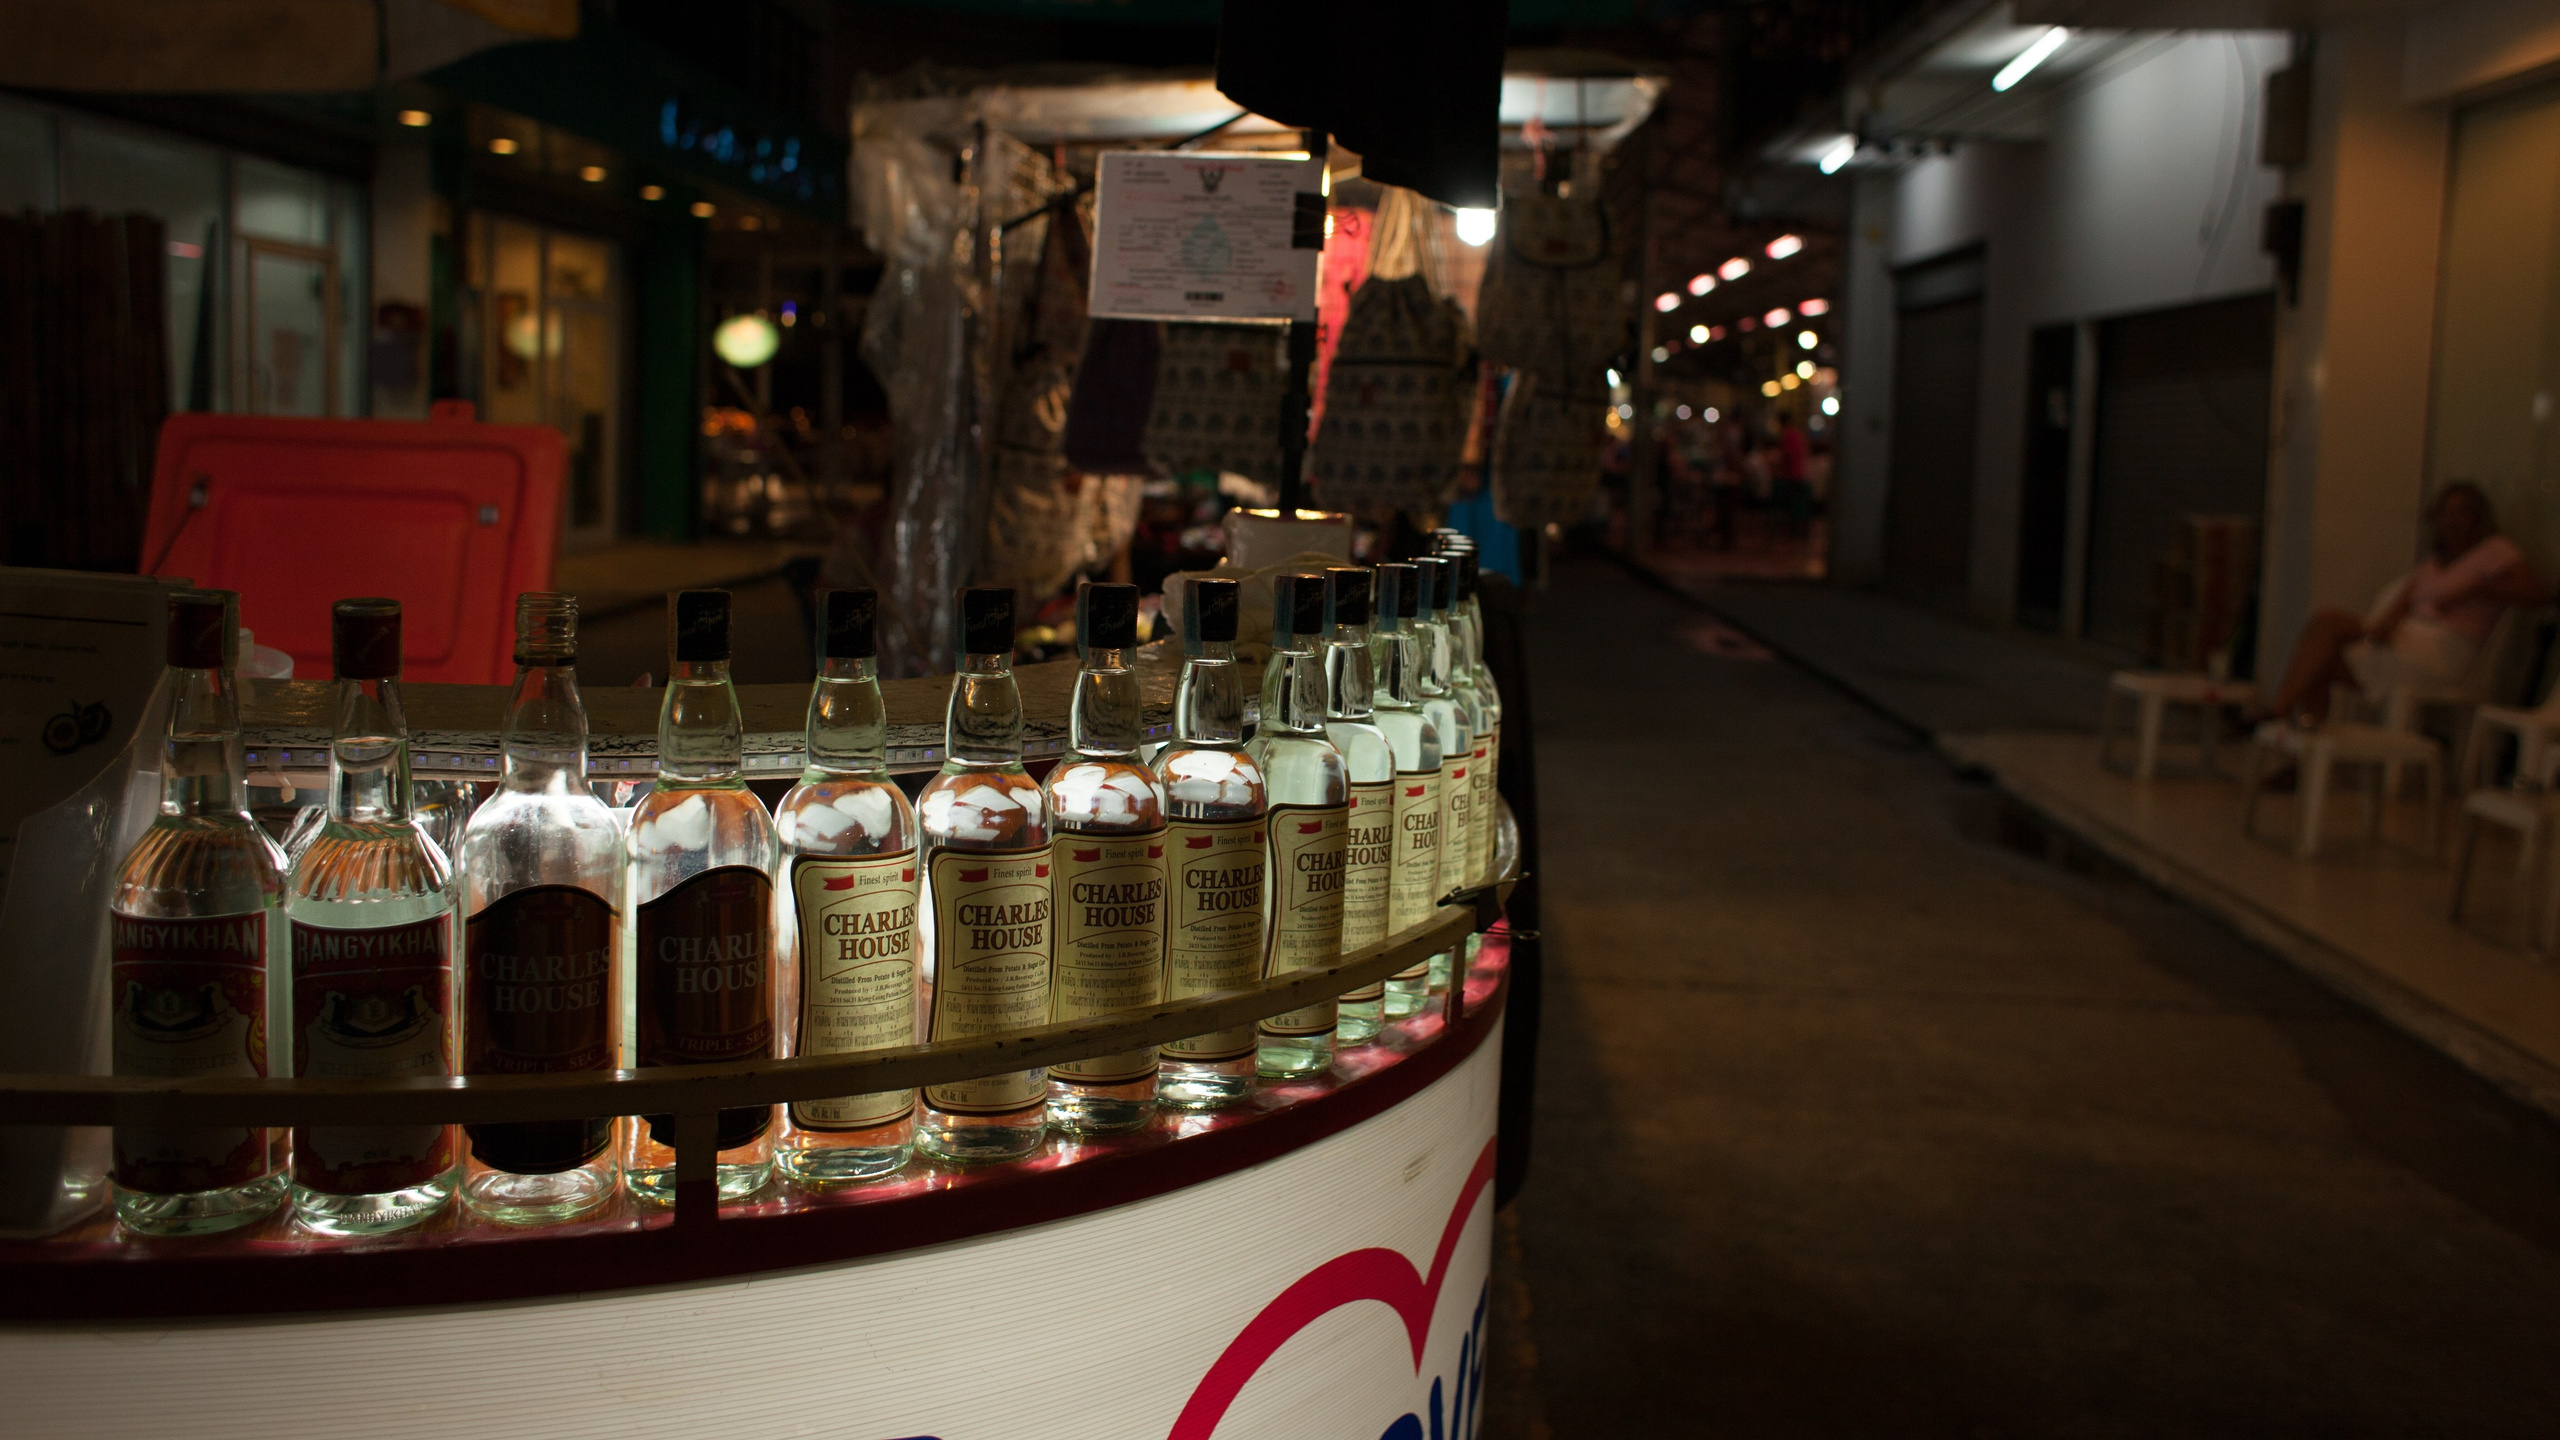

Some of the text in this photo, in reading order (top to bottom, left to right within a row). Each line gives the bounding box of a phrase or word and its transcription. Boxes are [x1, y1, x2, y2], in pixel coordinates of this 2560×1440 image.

[1404, 811, 1438, 831] CHAR
[1217, 836, 1236, 845] Finest
[1347, 824, 1393, 845] HARLE
[1412, 829, 1438, 849] HOU
[1105, 848, 1144, 861] Finest spirit
[1297, 848, 1346, 872] CHARL
[859, 871, 899, 886] Finest spirit
[993, 866, 1032, 880] Finest spirit
[1185, 862, 1265, 889] CHARLES
[1306, 869, 1345, 894] HOUS
[1072, 878, 1162, 904] CHARLES
[1197, 886, 1260, 911] HOUSE
[825, 903, 915, 936] CHARLES
[958, 898, 1049, 926] CHARLES
[1084, 902, 1156, 927] HOUSE
[114, 917, 263, 960] ANGYIKHAN
[296, 919, 449, 972] BANGYIKHAN
[659, 928, 772, 963] CHARLE
[838, 930, 910, 960] HOUSE
[971, 923, 1043, 950] HOUSE
[1077, 941, 1099, 949] Distilled
[480, 946, 611, 982] CHARLES
[676, 958, 768, 993] HOUSE
[963, 965, 986, 973] Distilled
[1005, 965, 1020, 973] Potato
[857, 976, 872, 984] From
[874, 973, 890, 982] Potato
[493, 980, 601, 1014] HOUSE
[678, 1036, 735, 1051] TRIPLE
[745, 1025, 767, 1045] SEC
[568, 1049, 597, 1069] SEC
